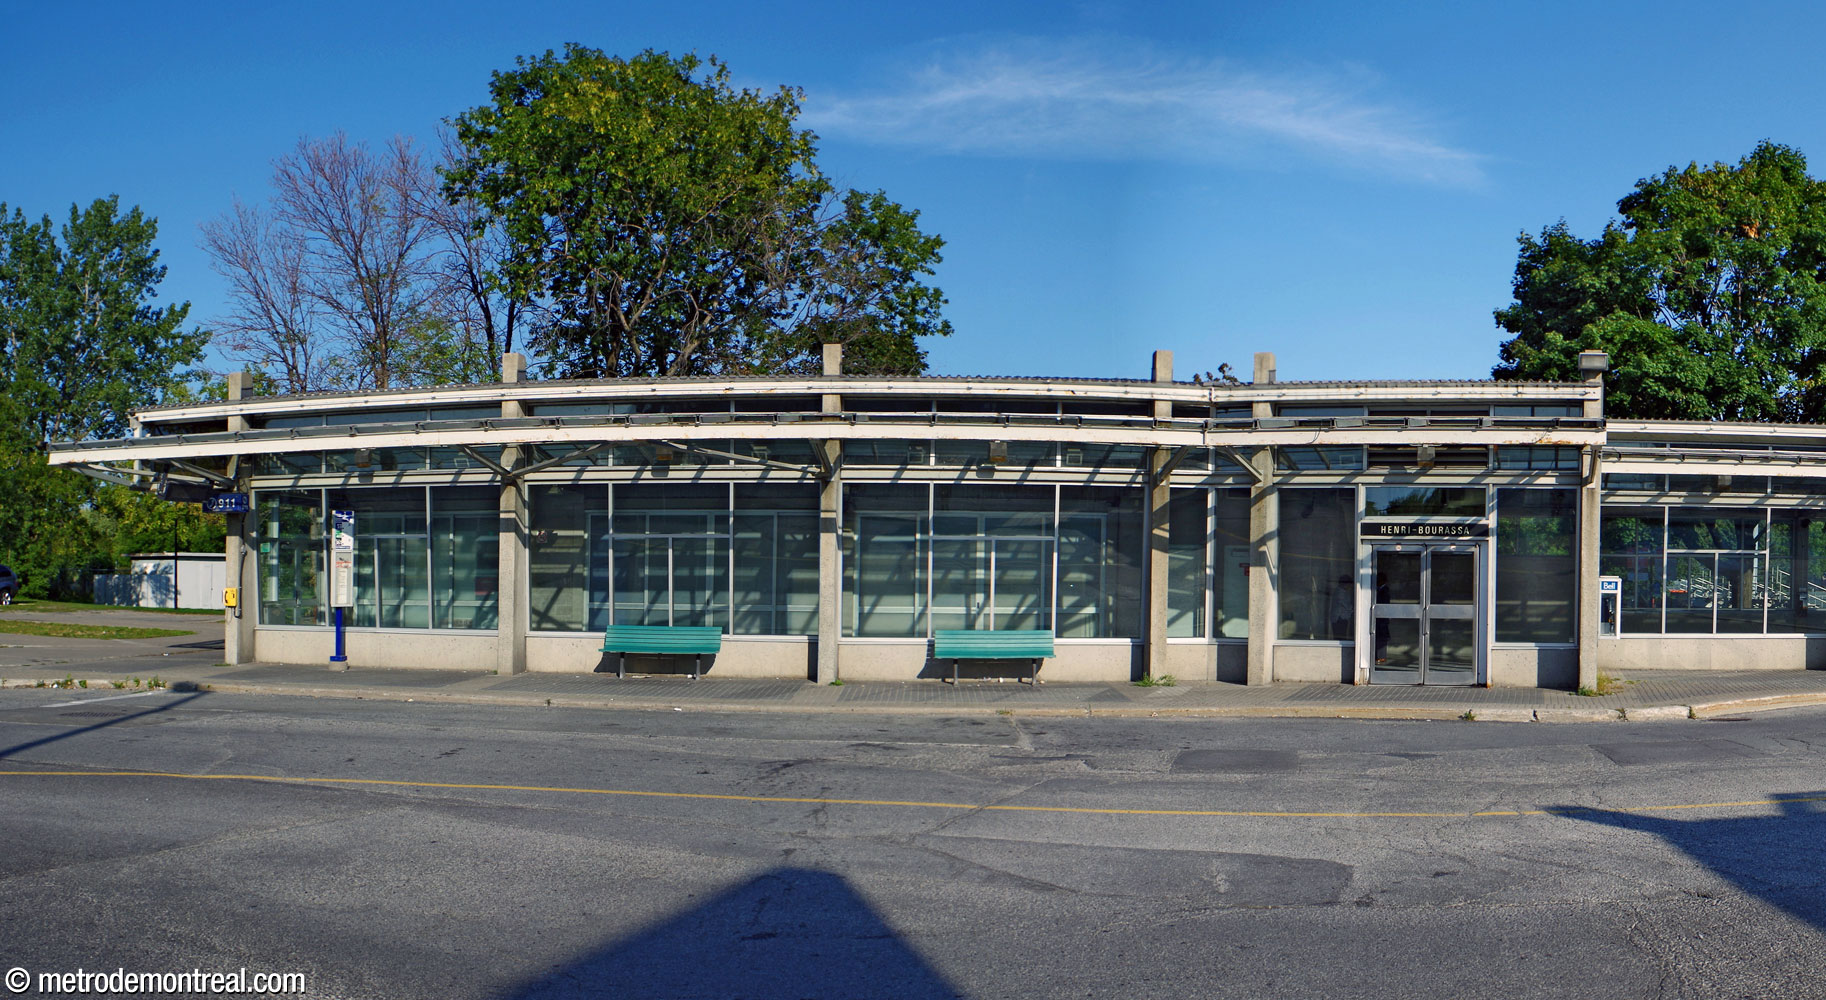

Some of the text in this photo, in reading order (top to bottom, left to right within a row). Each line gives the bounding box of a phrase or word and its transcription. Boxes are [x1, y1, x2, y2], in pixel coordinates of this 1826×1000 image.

[218, 498, 236, 509] 911
[1380, 525, 1470, 535] HENRI-BOURASSA
[1603, 582, 1616, 590] Bell
